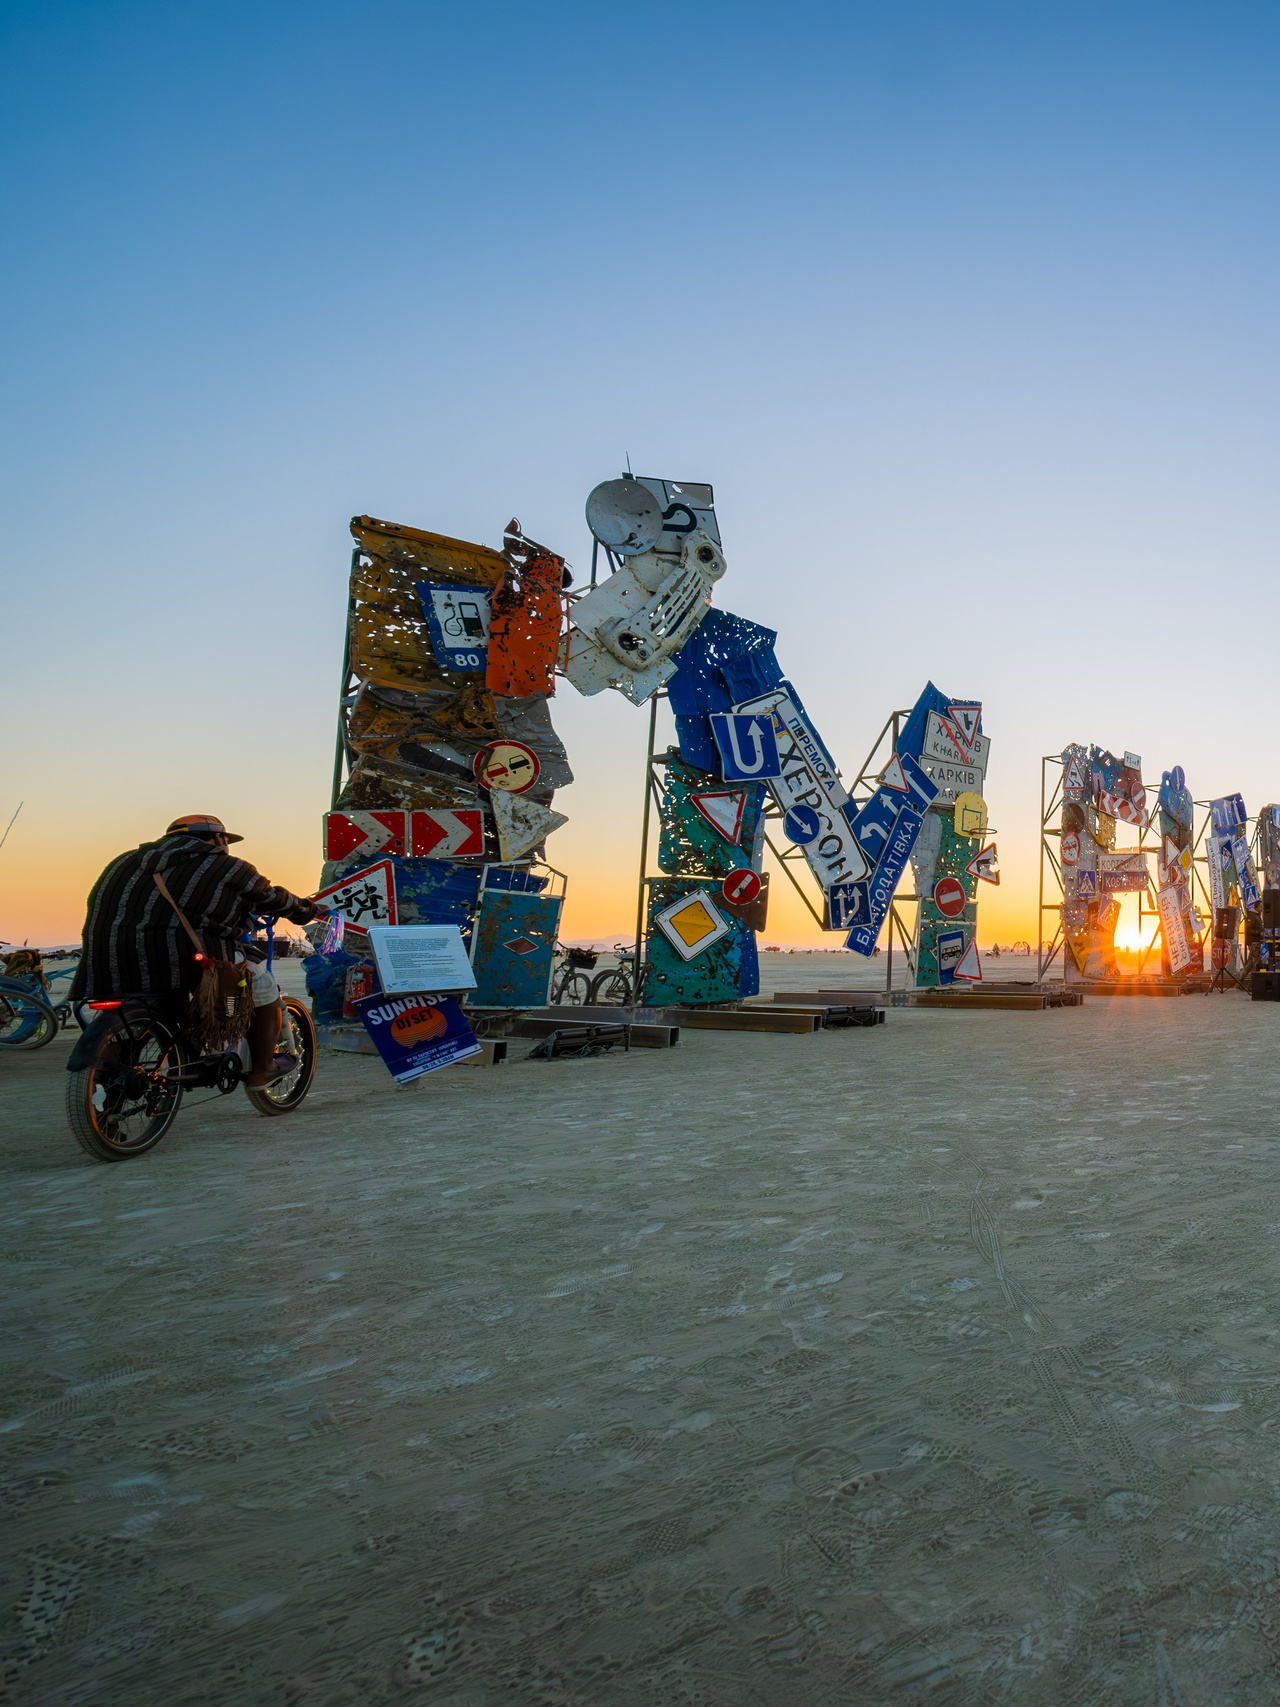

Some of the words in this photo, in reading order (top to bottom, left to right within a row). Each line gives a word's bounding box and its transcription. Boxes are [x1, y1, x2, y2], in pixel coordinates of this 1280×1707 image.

[455, 654, 480, 666] 80
[936, 722, 981, 753] ХАРКВ
[928, 766, 975, 785] ХАРКІВ
[367, 994, 447, 1025] SUNRISE
[395, 1016, 411, 1030] DJ
[411, 1008, 434, 1024] SET
